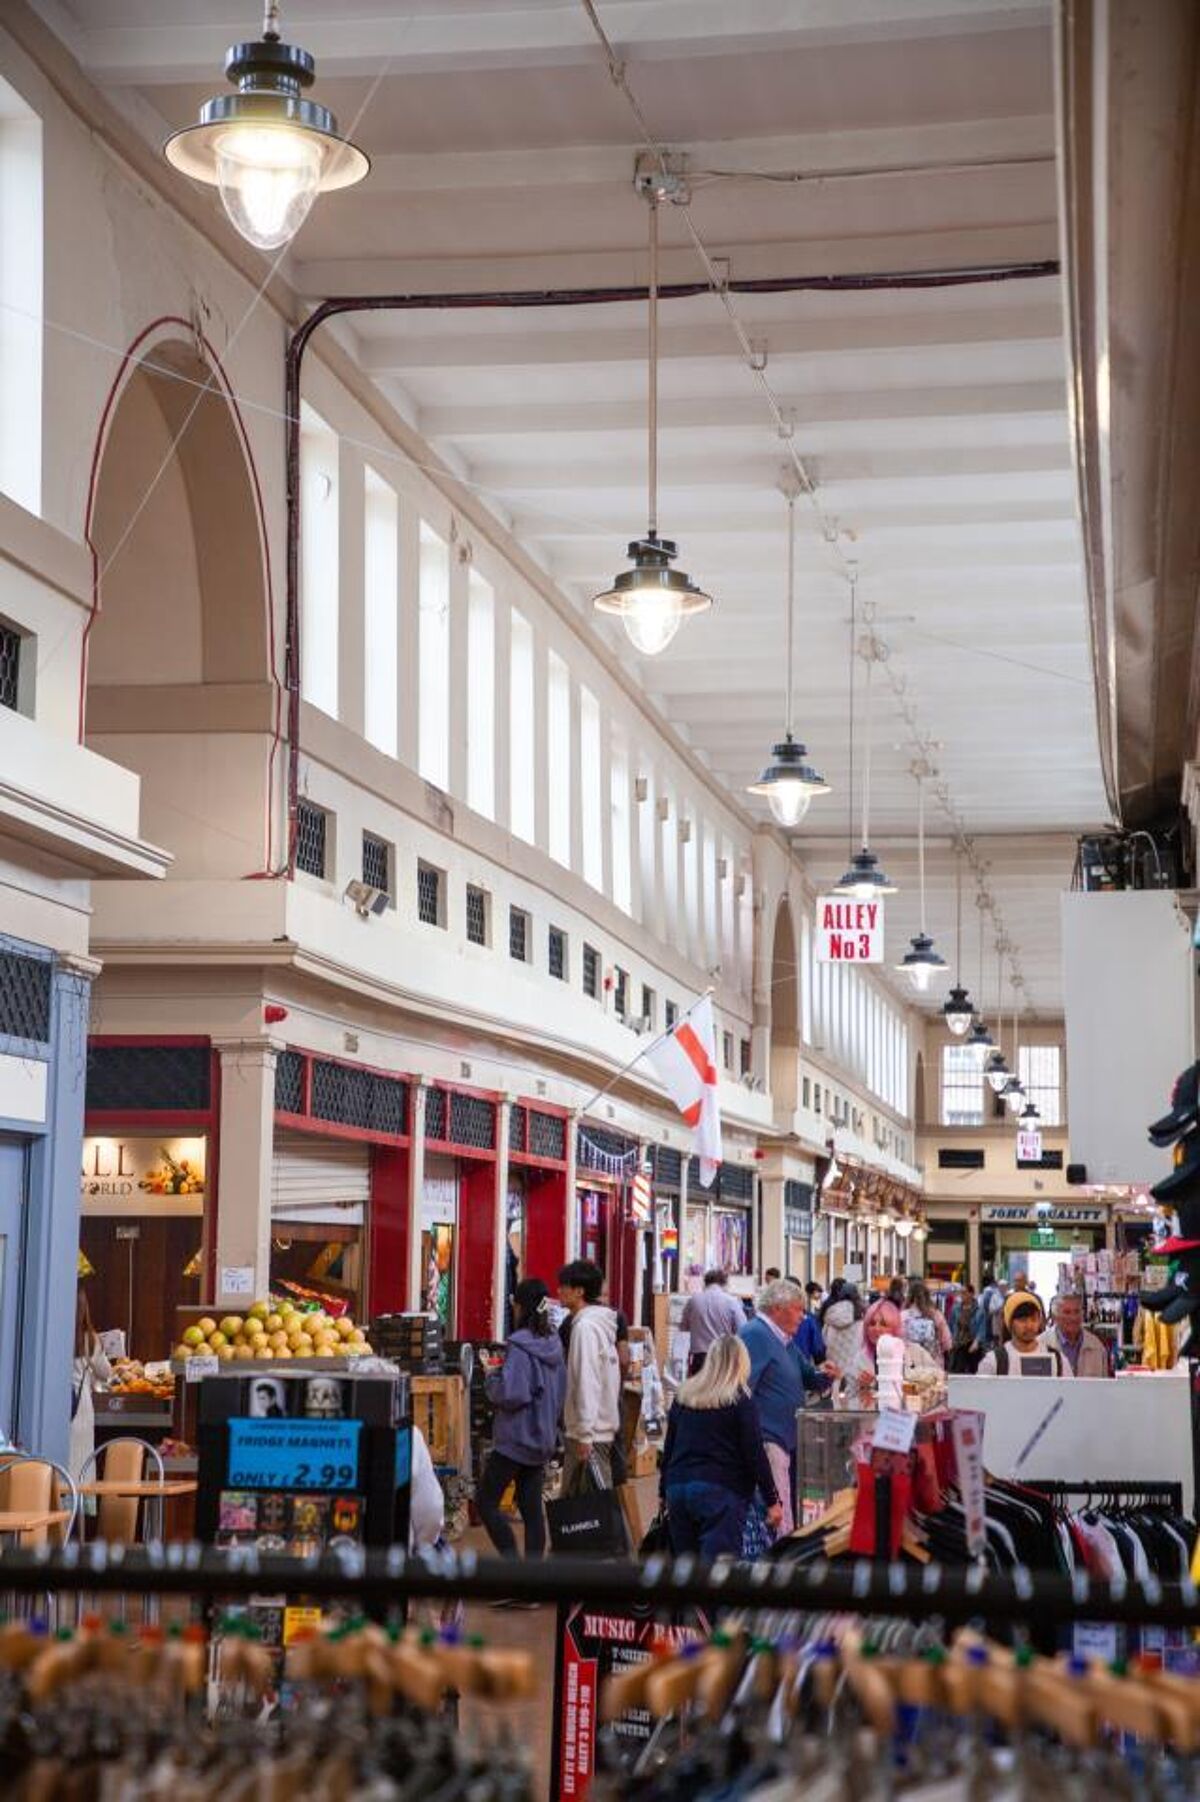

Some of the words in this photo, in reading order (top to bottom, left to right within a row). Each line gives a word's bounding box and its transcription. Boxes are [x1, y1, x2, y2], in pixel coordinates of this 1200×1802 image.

[823, 904, 877, 930] ALLEY
[81, 1144, 135, 1176] LL
[989, 1207, 1028, 1219] JOHN
[1038, 1209, 1102, 1220] QUALITY
[237, 1436, 282, 1448] FRIDGE
[287, 1437, 352, 1449] MAGNETS
[232, 1471, 277, 1486] ONLY
[293, 1463, 354, 1487] 2.99
[584, 1615, 636, 1641] MUSIC
[566, 1704, 577, 1743] MUSIC
[578, 1742, 589, 1775] ALLEY
[564, 1774, 576, 1794] LET
